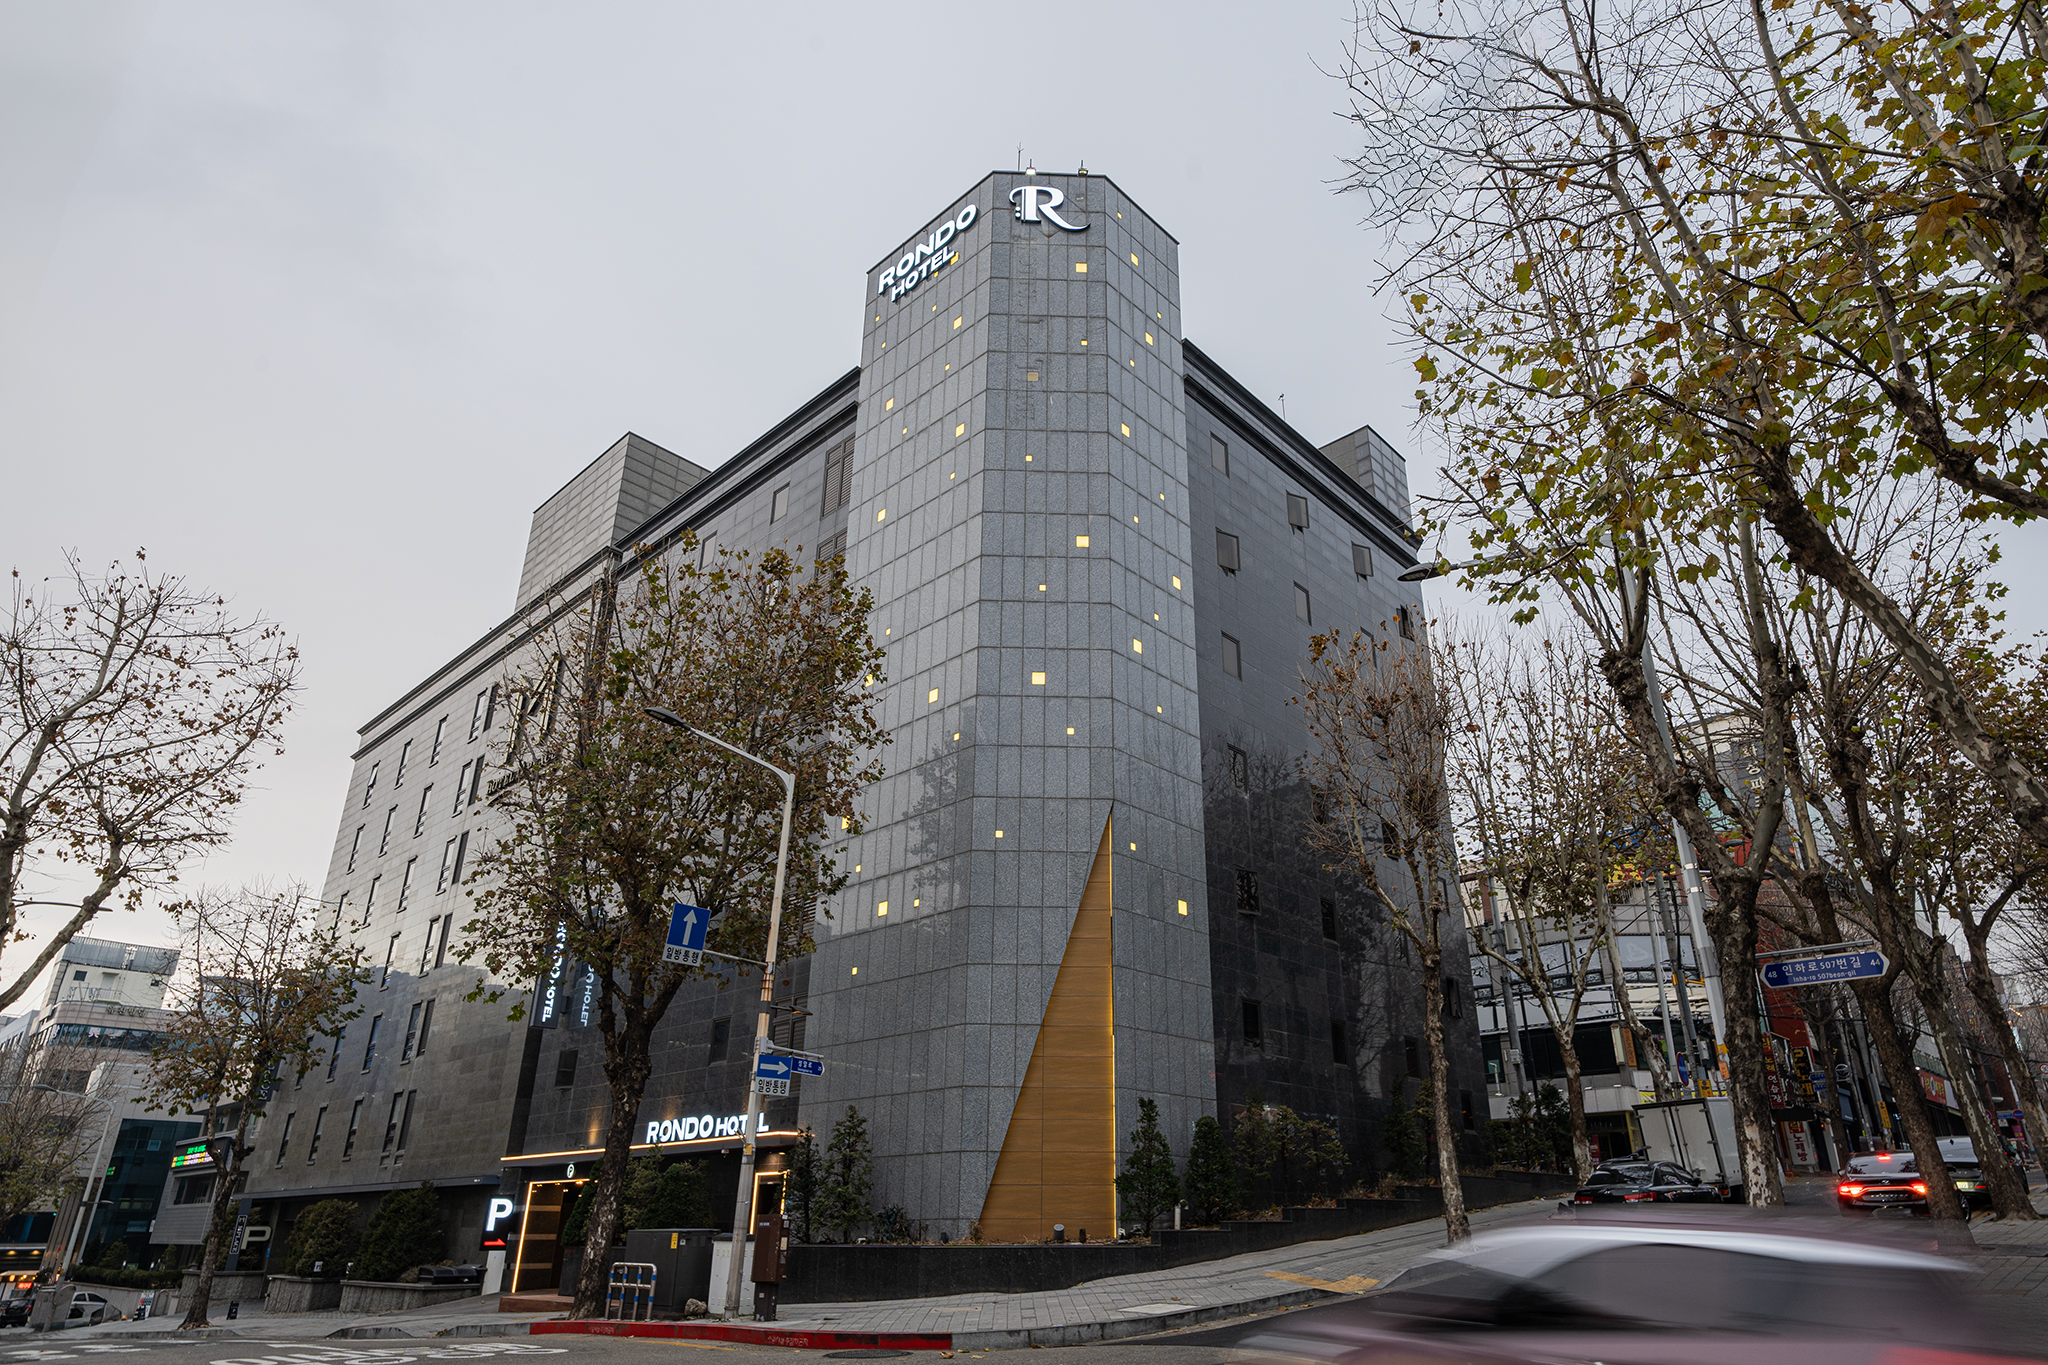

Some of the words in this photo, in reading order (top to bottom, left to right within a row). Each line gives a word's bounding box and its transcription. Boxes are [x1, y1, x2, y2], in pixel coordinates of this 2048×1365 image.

[1008, 185, 1091, 232] R
[878, 203, 979, 295] RONDO
[891, 245, 956, 303] HOTEL
[666, 946, 700, 964] 일방통행
[1767, 970, 1778, 979] 48
[1869, 958, 1881, 967] 44
[1792, 974, 1816, 983] Inha-ro
[758, 1079, 787, 1095] 일방통행
[645, 1114, 714, 1144] RONDO
[714, 1112, 770, 1138] HOTL
[486, 1198, 513, 1232] P
[240, 1225, 272, 1250] P
